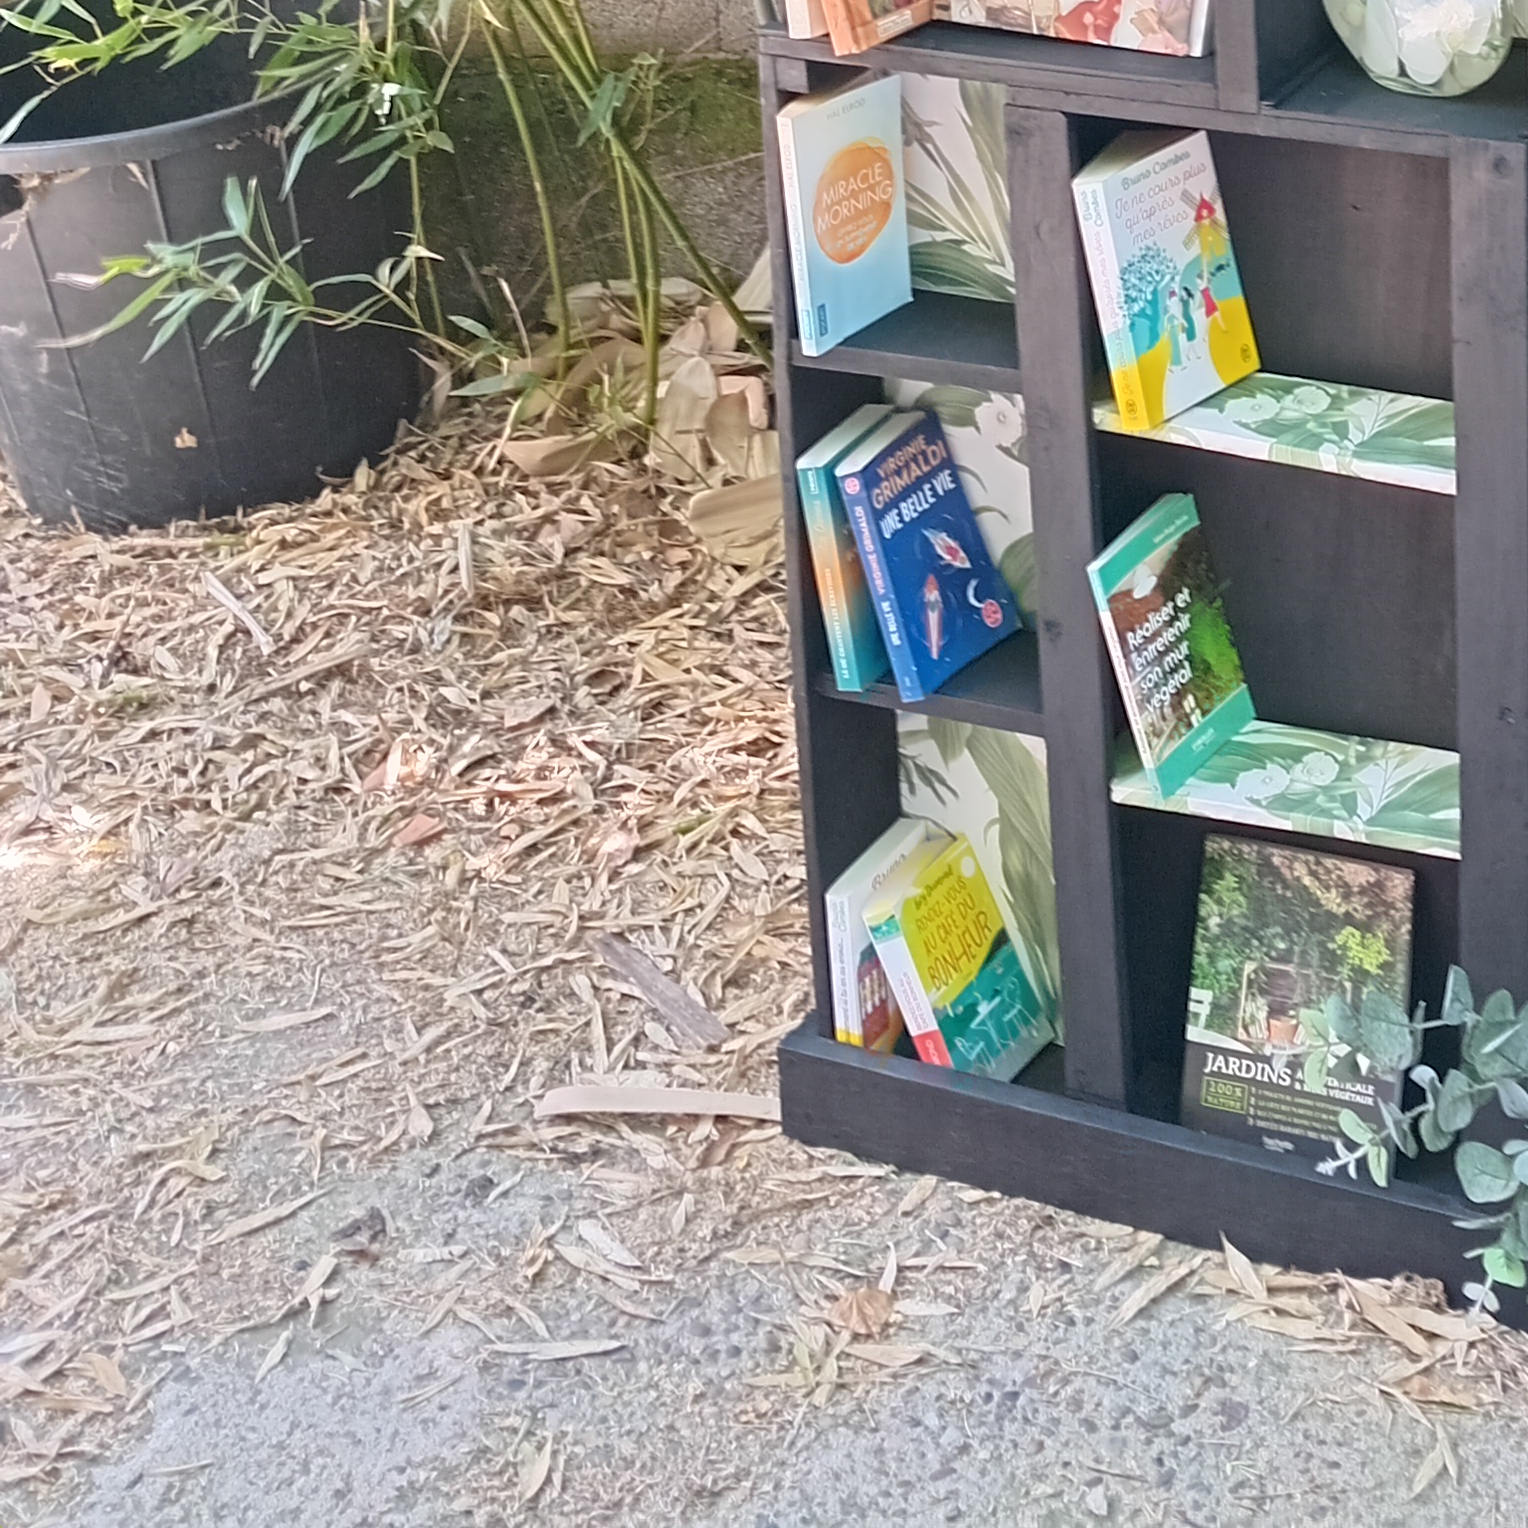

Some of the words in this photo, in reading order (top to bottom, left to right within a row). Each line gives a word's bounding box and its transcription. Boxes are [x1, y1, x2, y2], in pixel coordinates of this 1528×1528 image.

[821, 162, 885, 210] MIRACLE
[1120, 168, 1152, 191] Bruno
[1131, 189, 1146, 210] ne
[1146, 178, 1182, 201] cours
[1182, 162, 1208, 186] plus
[816, 179, 894, 235] MORNING
[1132, 228, 1158, 247] mes
[871, 439, 948, 510] GRIMALDI
[876, 433, 929, 480] VIRGINIE
[878, 507, 904, 540] UNE
[899, 484, 938, 524] BELLE
[933, 469, 957, 498] VIE
[854, 506, 875, 553] GRIMALDI
[867, 553, 886, 596] VIRGINIE
[1127, 607, 1176, 654] Réaliser
[1174, 584, 1193, 608] et
[1133, 611, 1193, 674] entretenir
[1139, 663, 1164, 695] son
[1162, 640, 1192, 673] mur
[923, 932, 938, 957] AU
[957, 892, 976, 921] DU
[927, 910, 993, 992] BONHEUR
[1204, 1052, 1292, 1087] JARDINS
[1328, 1089, 1376, 1107] VÉGÉTAUX
